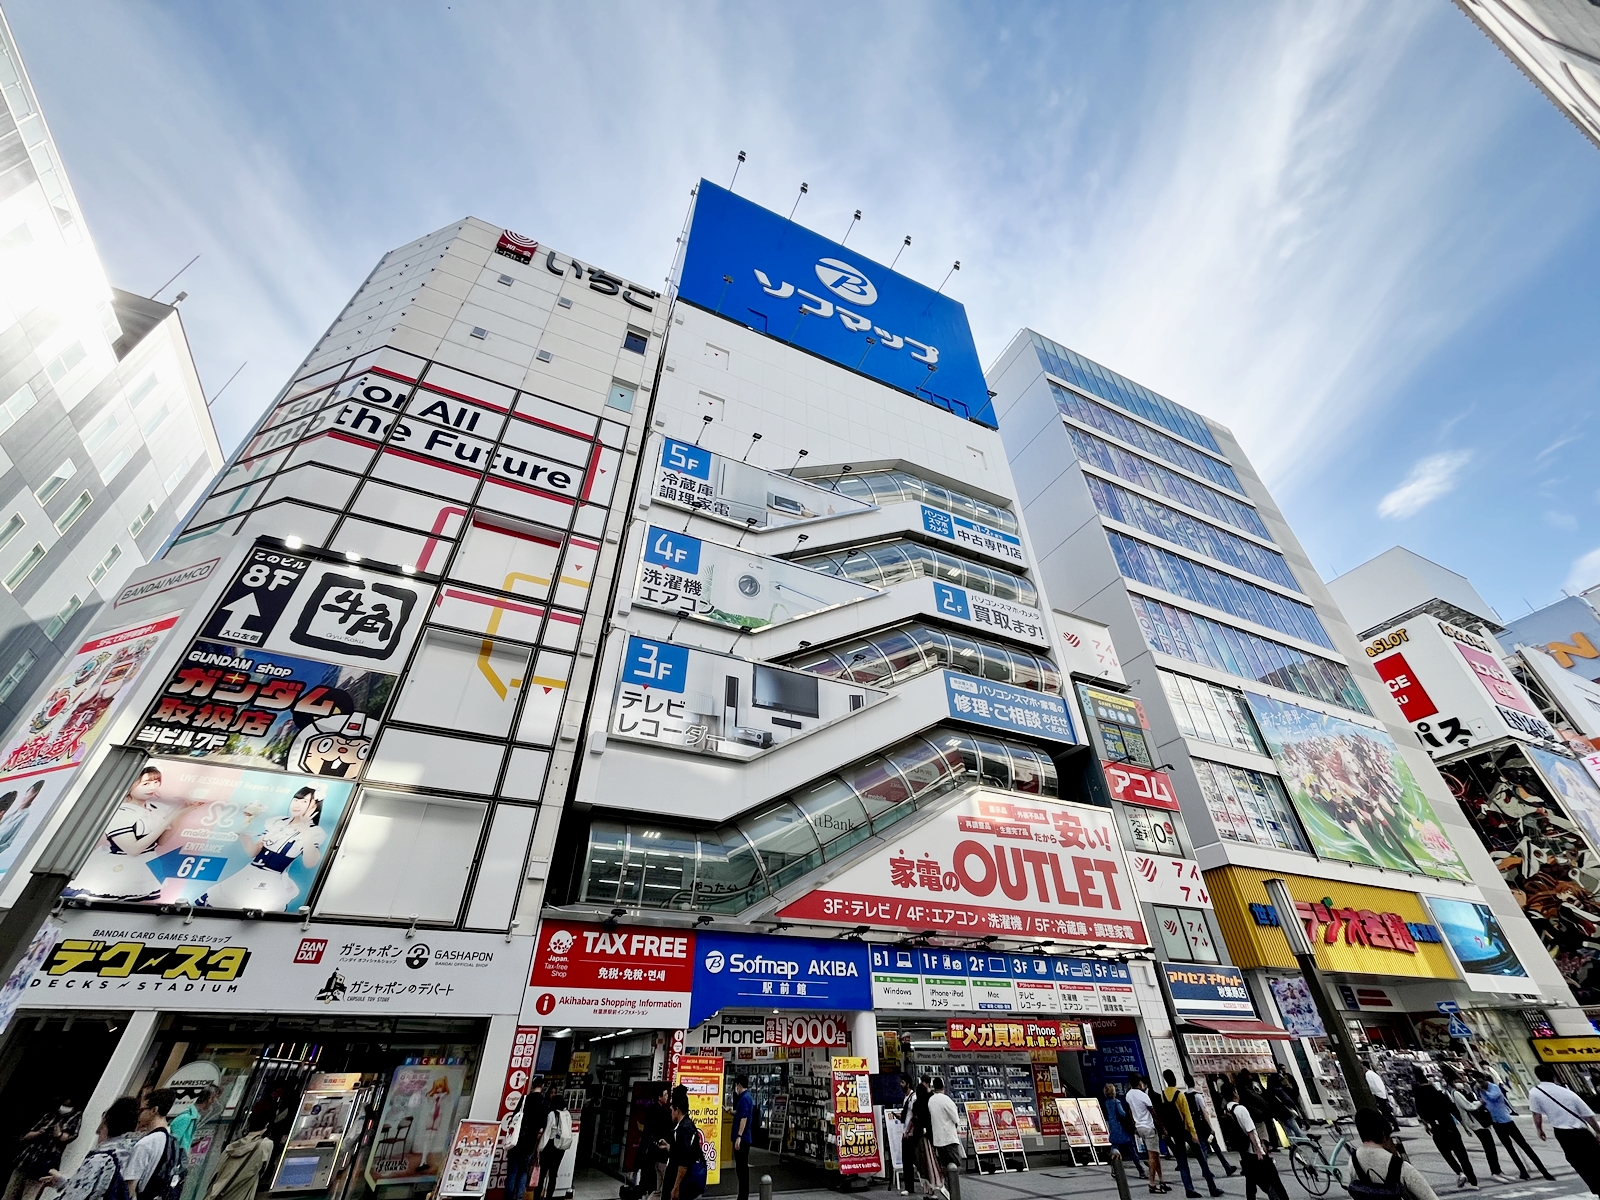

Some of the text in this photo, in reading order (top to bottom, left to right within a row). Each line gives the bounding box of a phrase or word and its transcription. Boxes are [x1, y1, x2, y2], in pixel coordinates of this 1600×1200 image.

[546, 250, 661, 313] いちご
[753, 268, 939, 364] ソフマップ
[417, 400, 480, 432] All
[334, 404, 411, 442] the
[424, 431, 571, 488] Future
[668, 444, 699, 471] 5F
[661, 471, 714, 497] 冷蔵庫
[924, 509, 949, 522] パソコン
[654, 533, 688, 563] 4F
[957, 530, 1022, 560] 中古専門店
[254, 551, 307, 570] このビル
[121, 565, 210, 601] BANDAI NAMCO
[242, 564, 300, 592] 8F
[642, 567, 702, 596] 洗濯機
[640, 586, 715, 614] エアコン
[941, 588, 963, 613] 2F
[320, 590, 394, 642] 牛角
[972, 603, 1044, 640] 買取ます!
[1365, 627, 1410, 658] &SLOT
[188, 650, 292, 677] GUNDAM shop
[633, 643, 673, 680] 3F
[168, 667, 335, 716] ガンダム
[622, 691, 686, 719] テレビ
[953, 693, 1043, 730] 修理・ご相談
[152, 698, 275, 737] 取扱店
[1041, 713, 1068, 727] お任せ
[136, 726, 229, 750] 当ビル7F
[618, 714, 727, 745] レコーダー
[1045, 724, 1070, 736] ください
[179, 773, 200, 783] LIVE
[1109, 768, 1173, 803] アコム
[1033, 832, 1057, 844] だから
[1051, 811, 1112, 852] 安い!
[184, 842, 224, 853] ENTRANCE
[176, 856, 212, 879] 6F
[889, 839, 1122, 911] 家電の OUTLET
[823, 898, 891, 920] 3F:テレビ
[93, 929, 129, 938] BANDAI
[130, 931, 156, 940] CARD
[157, 933, 189, 942] GAMES
[583, 931, 688, 958] TAX FREE
[297, 951, 316, 961] DAI
[301, 941, 326, 952] BAN
[339, 943, 403, 958] ガシャポン
[434, 949, 494, 962] GASHAPON
[544, 962, 569, 971] Tax-free
[729, 953, 859, 980] Sofmap AKIBA
[873, 950, 889, 967] B1
[923, 953, 938, 969] 1F
[969, 956, 985, 971] 2F
[1013, 958, 1028, 974] 3F
[1055, 961, 1069, 976] 4F
[551, 970, 567, 978] Shop
[1095, 963, 1108, 978] 5F
[30, 979, 238, 993] DECKS STADIUM
[349, 981, 454, 996] ガシャポンのデパート
[762, 981, 807, 996] 駅前館
[883, 987, 912, 995] Windows
[1019, 992, 1035, 1000] テレビ
[558, 996, 682, 1009] Akihabara Shopping Information
[931, 999, 949, 1007] カメラ
[1020, 1001, 1047, 1009] レコーダー
[1063, 1003, 1083, 1011] エアコン
[702, 1025, 765, 1045] iPhone
[962, 1023, 1026, 1047] メガ買取
[1027, 1024, 1056, 1036] iPhone
[834, 1059, 842, 1068] 2F
[835, 1081, 857, 1097] メガ
[704, 1107, 719, 1116] iPad
